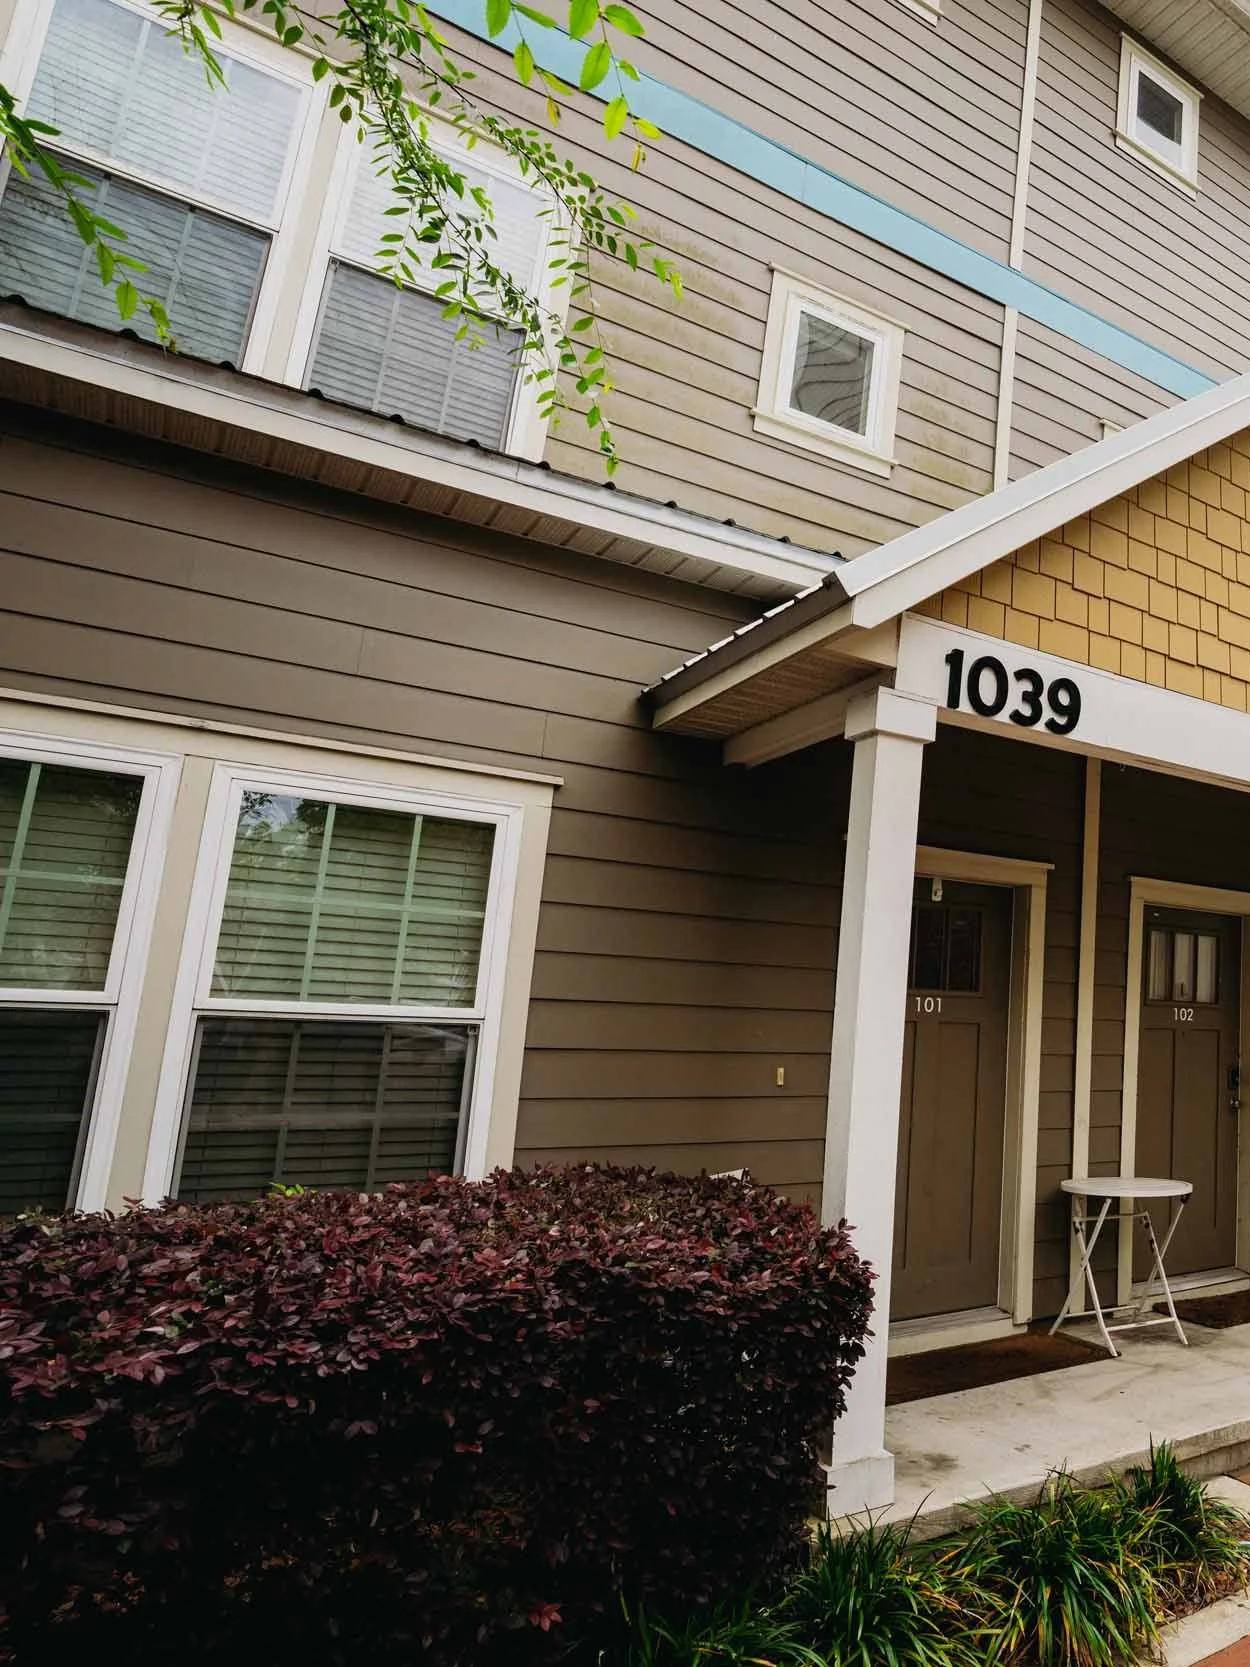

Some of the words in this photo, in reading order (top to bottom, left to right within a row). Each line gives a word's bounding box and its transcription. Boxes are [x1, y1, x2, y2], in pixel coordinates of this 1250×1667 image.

[944, 648, 1082, 735] 1039
[915, 997, 942, 1013] 101
[1173, 1007, 1194, 1021] 102
